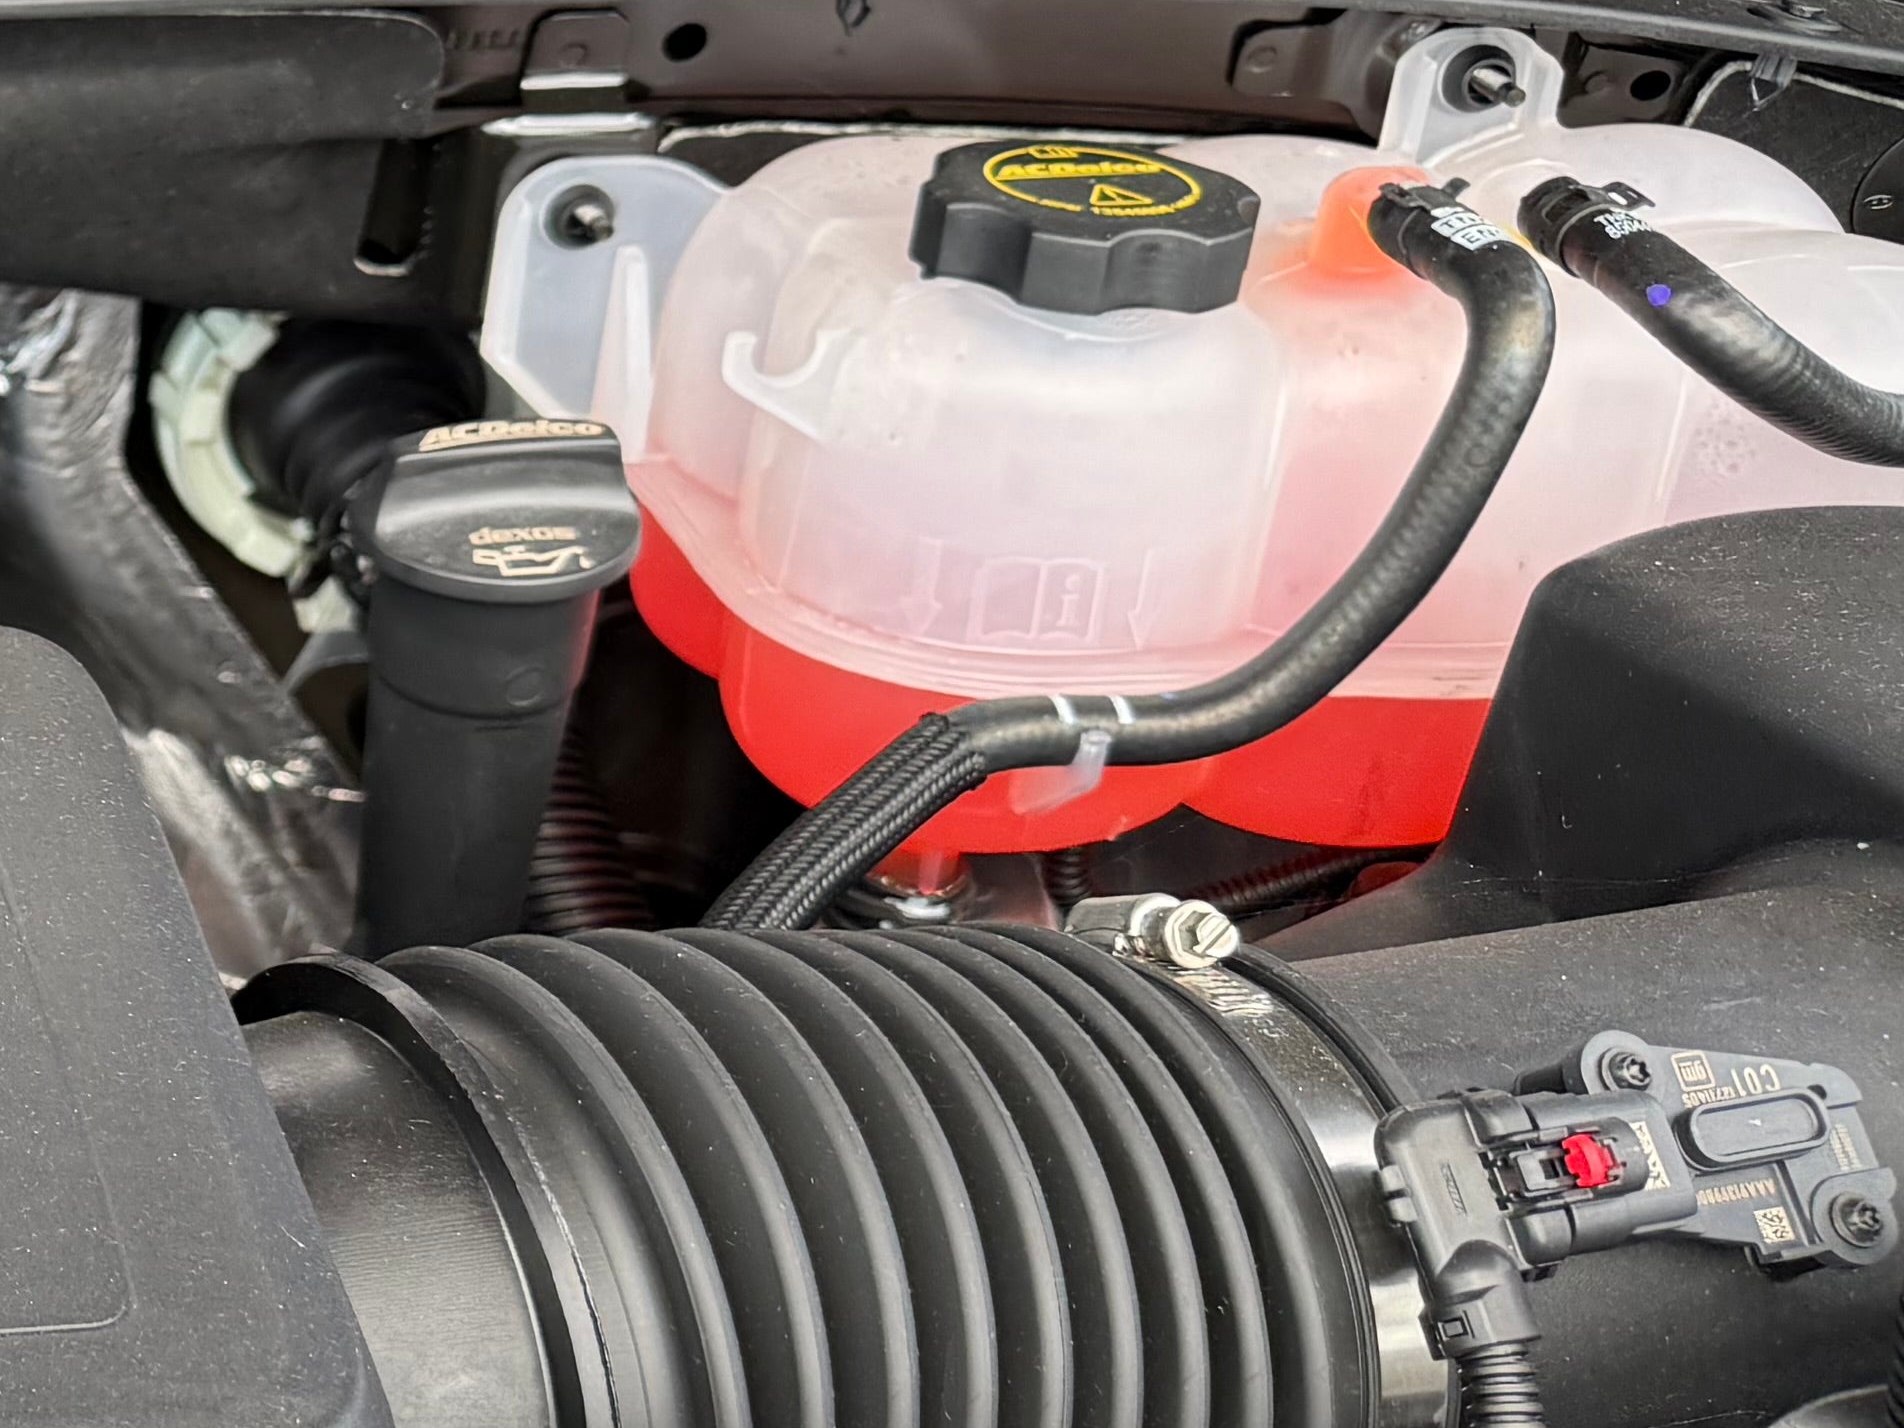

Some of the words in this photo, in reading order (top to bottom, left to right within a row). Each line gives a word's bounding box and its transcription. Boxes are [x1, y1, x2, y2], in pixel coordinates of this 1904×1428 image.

[419, 419, 607, 453] ACDelco
[468, 524, 578, 547] dexos
[1730, 1063, 1781, 1097] C01
